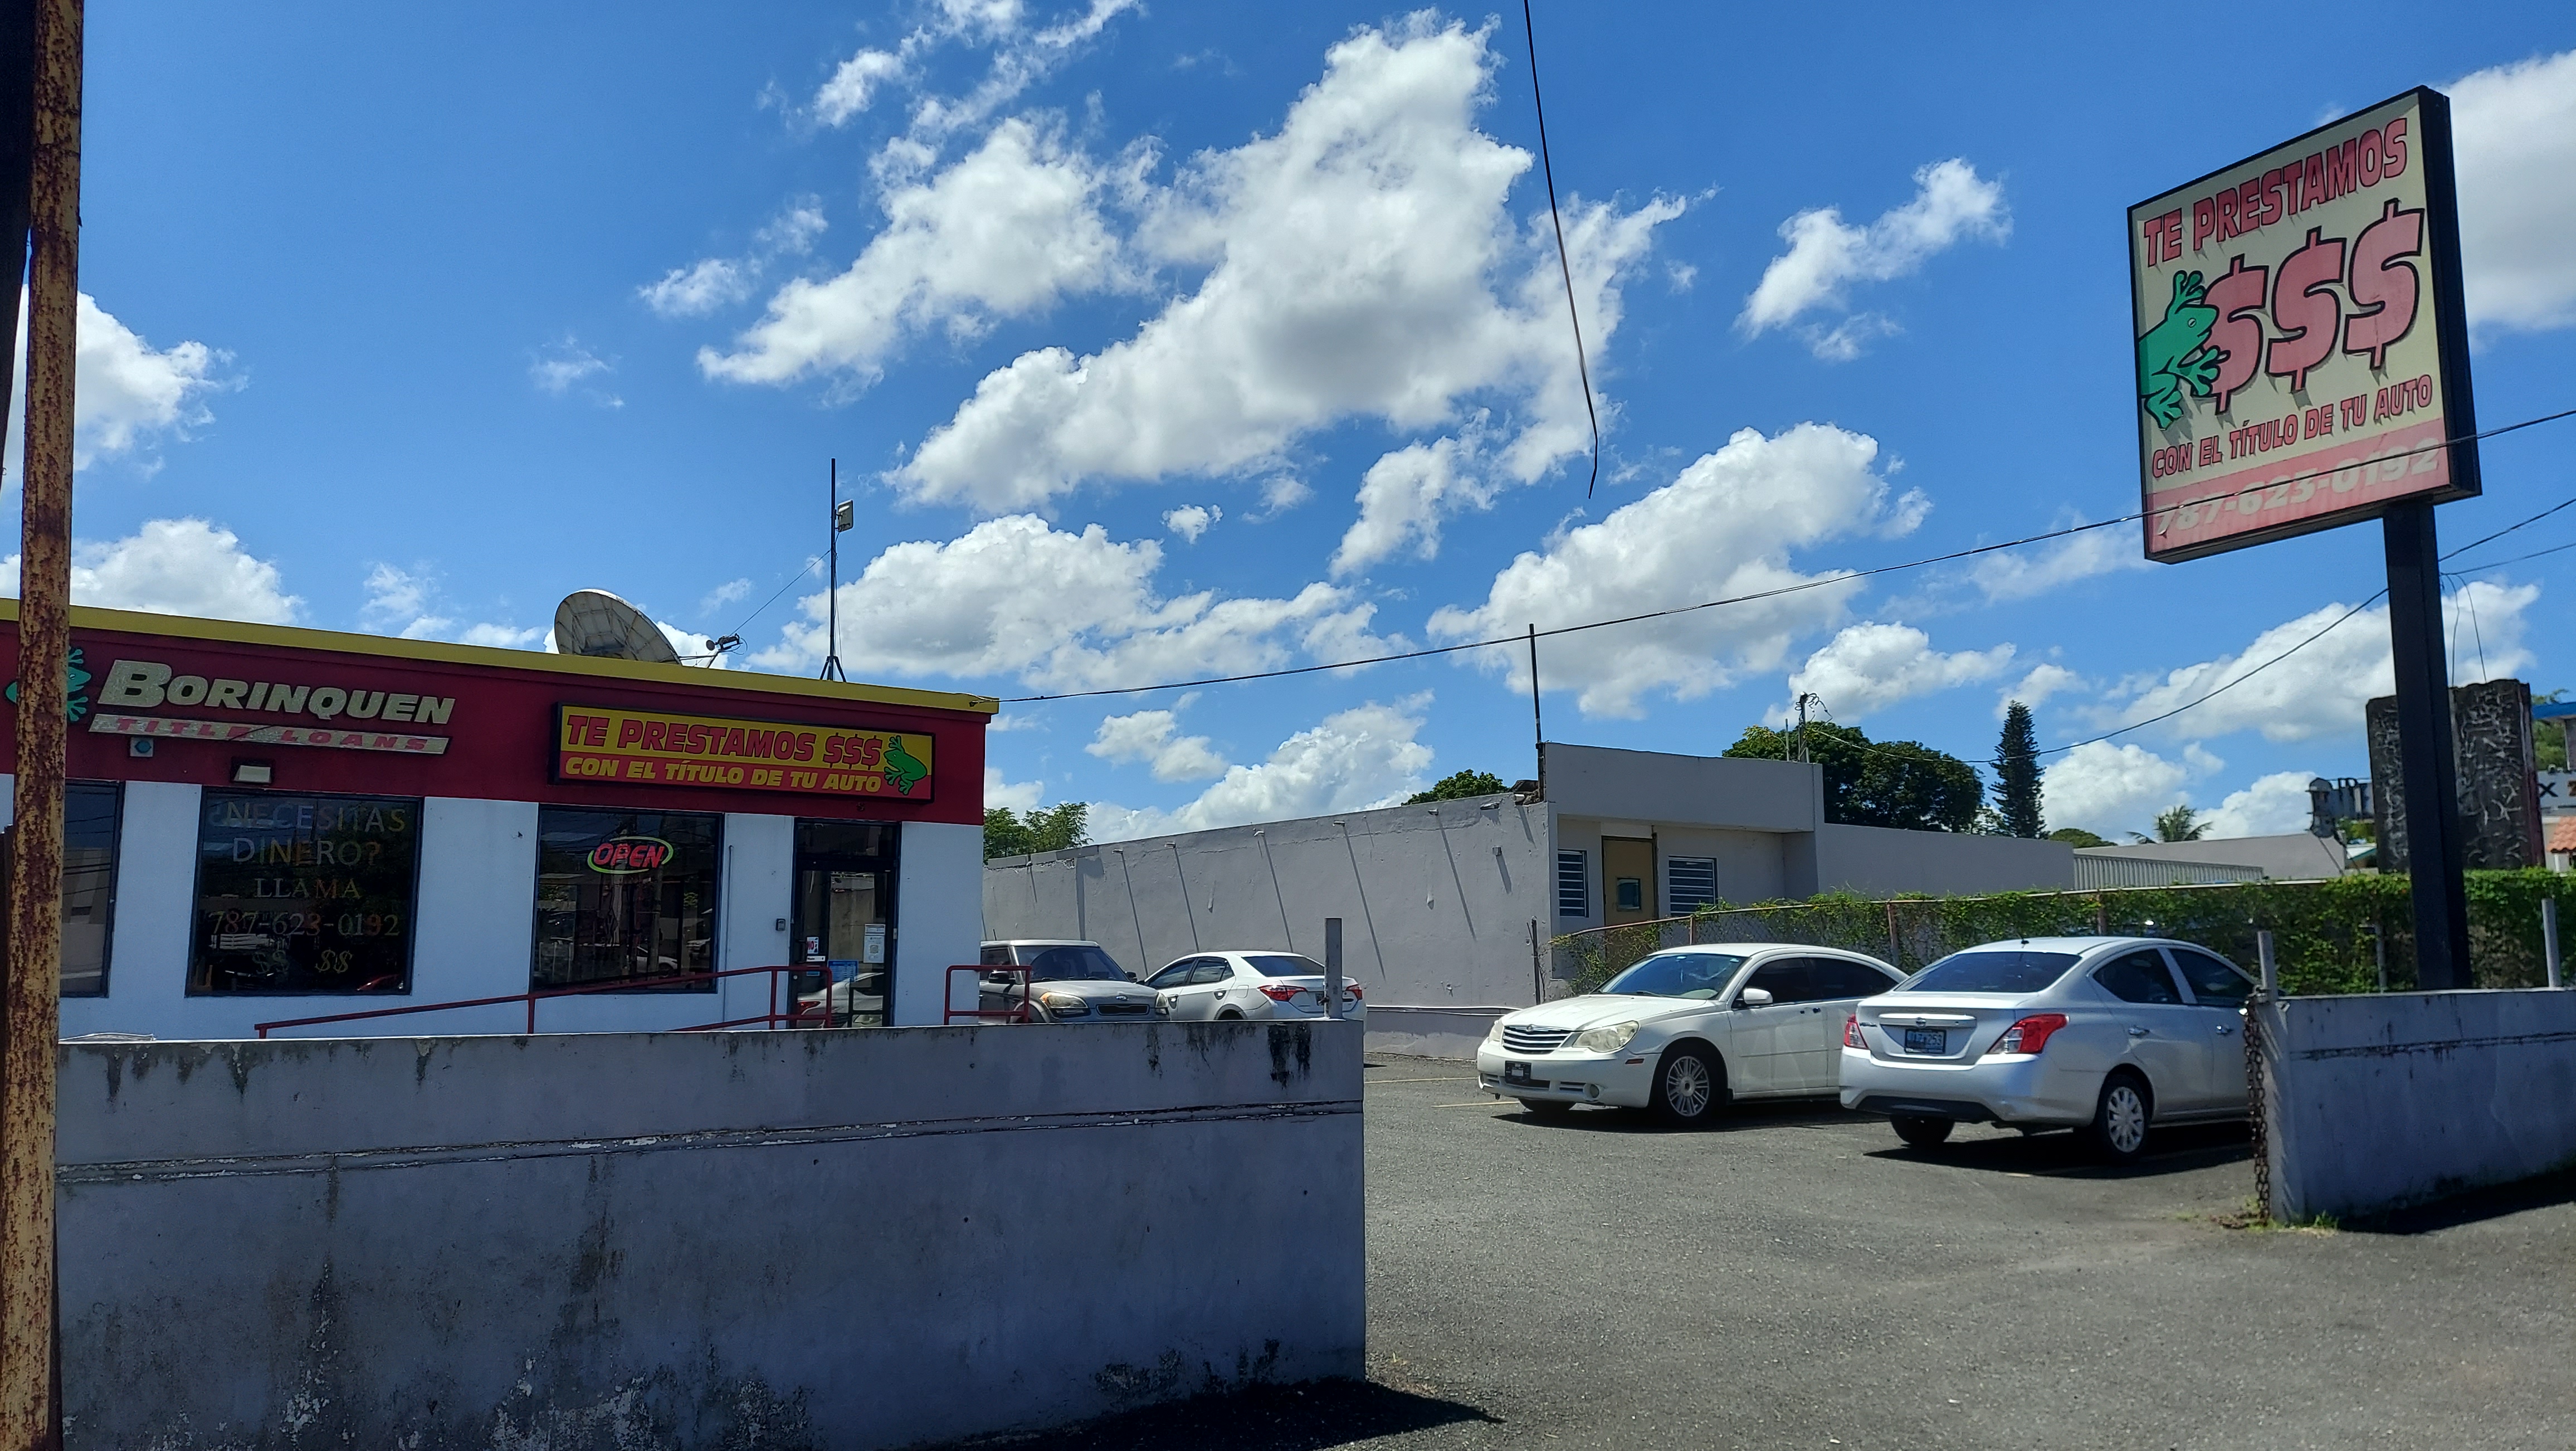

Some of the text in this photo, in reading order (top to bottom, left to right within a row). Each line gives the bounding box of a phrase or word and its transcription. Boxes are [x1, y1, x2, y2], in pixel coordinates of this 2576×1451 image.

[2144, 117, 2408, 268] TE PRESTAMOS
[2153, 374, 2433, 478] CON EL TÍTULO DE TU AUTO
[2155, 437, 2443, 535] 787-623-0192
[116, 718, 428, 751] TITLE LOANS
[567, 714, 883, 770] TE PRESTAMOS $$$
[565, 757, 881, 792] CON EL TÍTULO DE TU AUTO
[233, 837, 382, 866] DINERO?
[593, 843, 665, 869] OPEN
[253, 878, 361, 900] LLAMA
